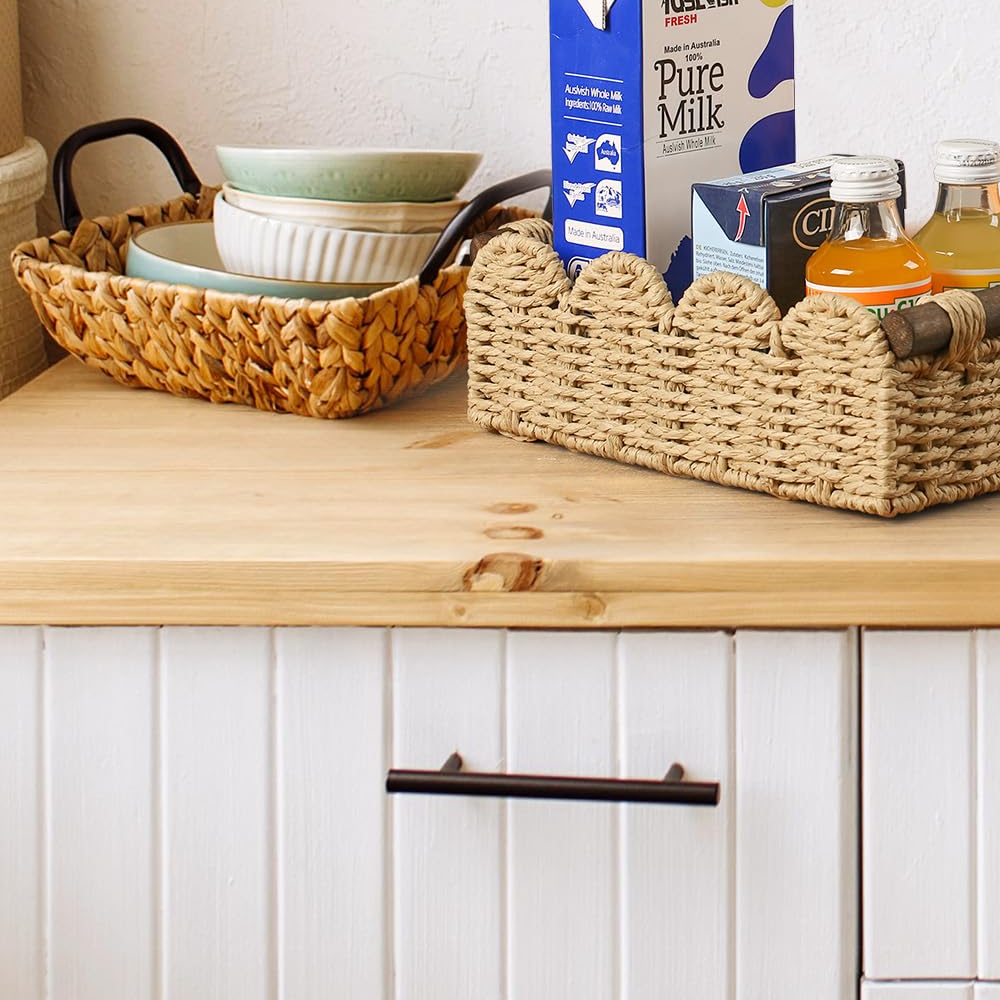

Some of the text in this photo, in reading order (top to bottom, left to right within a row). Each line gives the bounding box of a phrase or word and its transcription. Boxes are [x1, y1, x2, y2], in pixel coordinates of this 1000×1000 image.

[665, 14, 697, 27] FRESH
[664, 45, 682, 53] Made
[691, 39, 720, 50] Australia
[685, 53, 703, 62] 100%
[654, 59, 724, 100] Pure
[591, 88, 609, 99] Whole
[611, 91, 623, 101] Milk
[613, 104, 622, 114] Milk
[657, 95, 725, 138] Milk
[686, 138, 703, 149] Whole
[704, 136, 716, 145] Milk
[568, 226, 584, 237] Made
[592, 231, 620, 243] Australia
